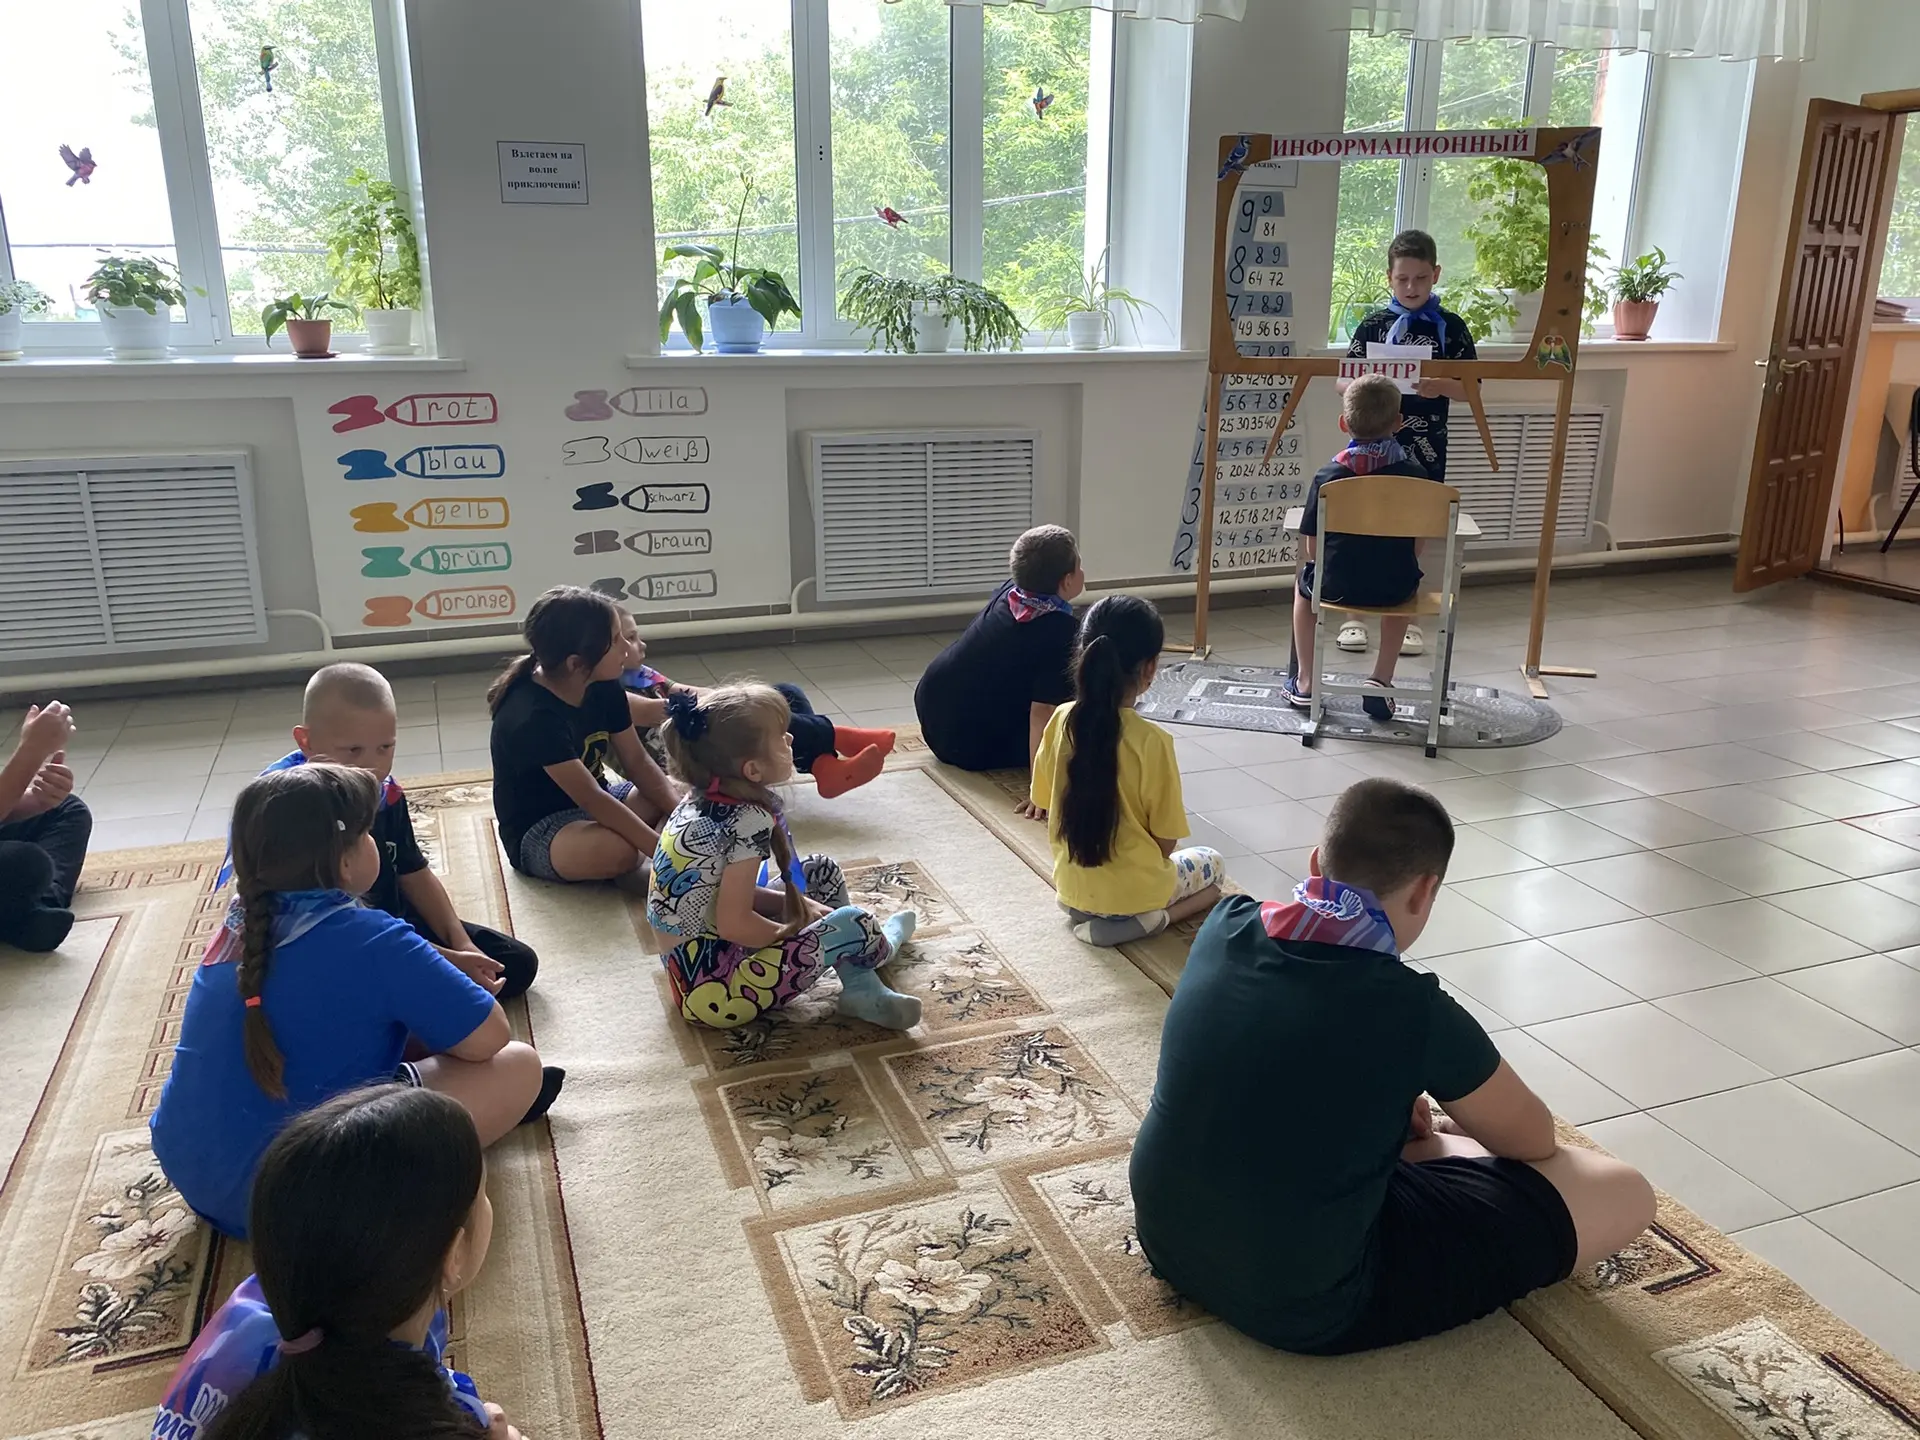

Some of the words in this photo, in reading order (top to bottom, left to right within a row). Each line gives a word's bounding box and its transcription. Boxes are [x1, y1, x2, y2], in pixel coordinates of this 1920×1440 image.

[1272, 129, 1530, 157] ИНФОРМАЦИОННЫЙ
[511, 148, 558, 160] Взлетаем
[560, 151, 573, 160] на
[528, 166, 559, 174] волне
[507, 180, 581, 190] приключений!
[1262, 195, 1273, 214] 9
[1240, 199, 1254, 233] 9
[1263, 221, 1276, 237] 81
[1255, 246, 1264, 264] 8
[1272, 246, 1281, 264] 9
[1229, 245, 1247, 285] 8
[1248, 271, 1263, 285] 64
[1269, 271, 1284, 287] 72
[1245, 294, 1255, 313] 7
[1261, 294, 1270, 314] 8
[1273, 294, 1284, 314] 9
[1238, 320, 1253, 336] 49
[1256, 320, 1271, 337] 56
[1341, 362, 1417, 380] ЦЕНТР
[427, 397, 479, 421] rot
[648, 391, 689, 410] lila
[1225, 394, 1237, 411] 5
[1238, 394, 1247, 411] 6
[1253, 393, 1262, 409] 7
[1268, 392, 1277, 410] 8
[1219, 417, 1235, 433] 25
[1235, 416, 1250, 431] 30
[1250, 415, 1264, 431] 35
[1264, 415, 1277, 430] 40
[644, 440, 699, 462] weiß
[1217, 440, 1226, 456] 4
[1231, 441, 1242, 457] 5
[1245, 440, 1254, 456] 6
[1275, 439, 1284, 456] 8
[1288, 438, 1298, 454] 9
[427, 449, 487, 471] blau
[1229, 464, 1243, 478] 20
[1243, 463, 1256, 477] 24
[1258, 463, 1271, 477] 28
[1271, 462, 1285, 477] 32
[1287, 461, 1301, 477] 36
[648, 491, 697, 503] schwarz
[1224, 488, 1231, 501] 4
[1237, 487, 1246, 502] 5
[1250, 486, 1258, 501] 6
[1266, 485, 1275, 498] 7
[1279, 484, 1288, 500] 8
[1292, 483, 1302, 499] 9
[434, 501, 490, 525] gelb
[1182, 487, 1201, 525] 3
[1219, 510, 1232, 525] 12
[1233, 508, 1249, 525] 15
[1247, 508, 1259, 525] 18
[1261, 507, 1274, 522] 21
[653, 535, 707, 550] braun
[1215, 530, 1223, 547] 3
[1229, 531, 1238, 546] 4
[1243, 529, 1252, 546] 5
[1254, 528, 1264, 544] 6
[1269, 526, 1279, 541] 7
[441, 549, 499, 571] grün
[1174, 532, 1193, 571] 2
[1211, 552, 1220, 569] 6
[1228, 551, 1235, 568] 8
[1239, 551, 1251, 567] 10
[1252, 548, 1265, 565] 12
[1266, 547, 1278, 564] 14
[1279, 546, 1292, 562] 16
[655, 579, 702, 597] grau
[442, 593, 509, 612] orange
